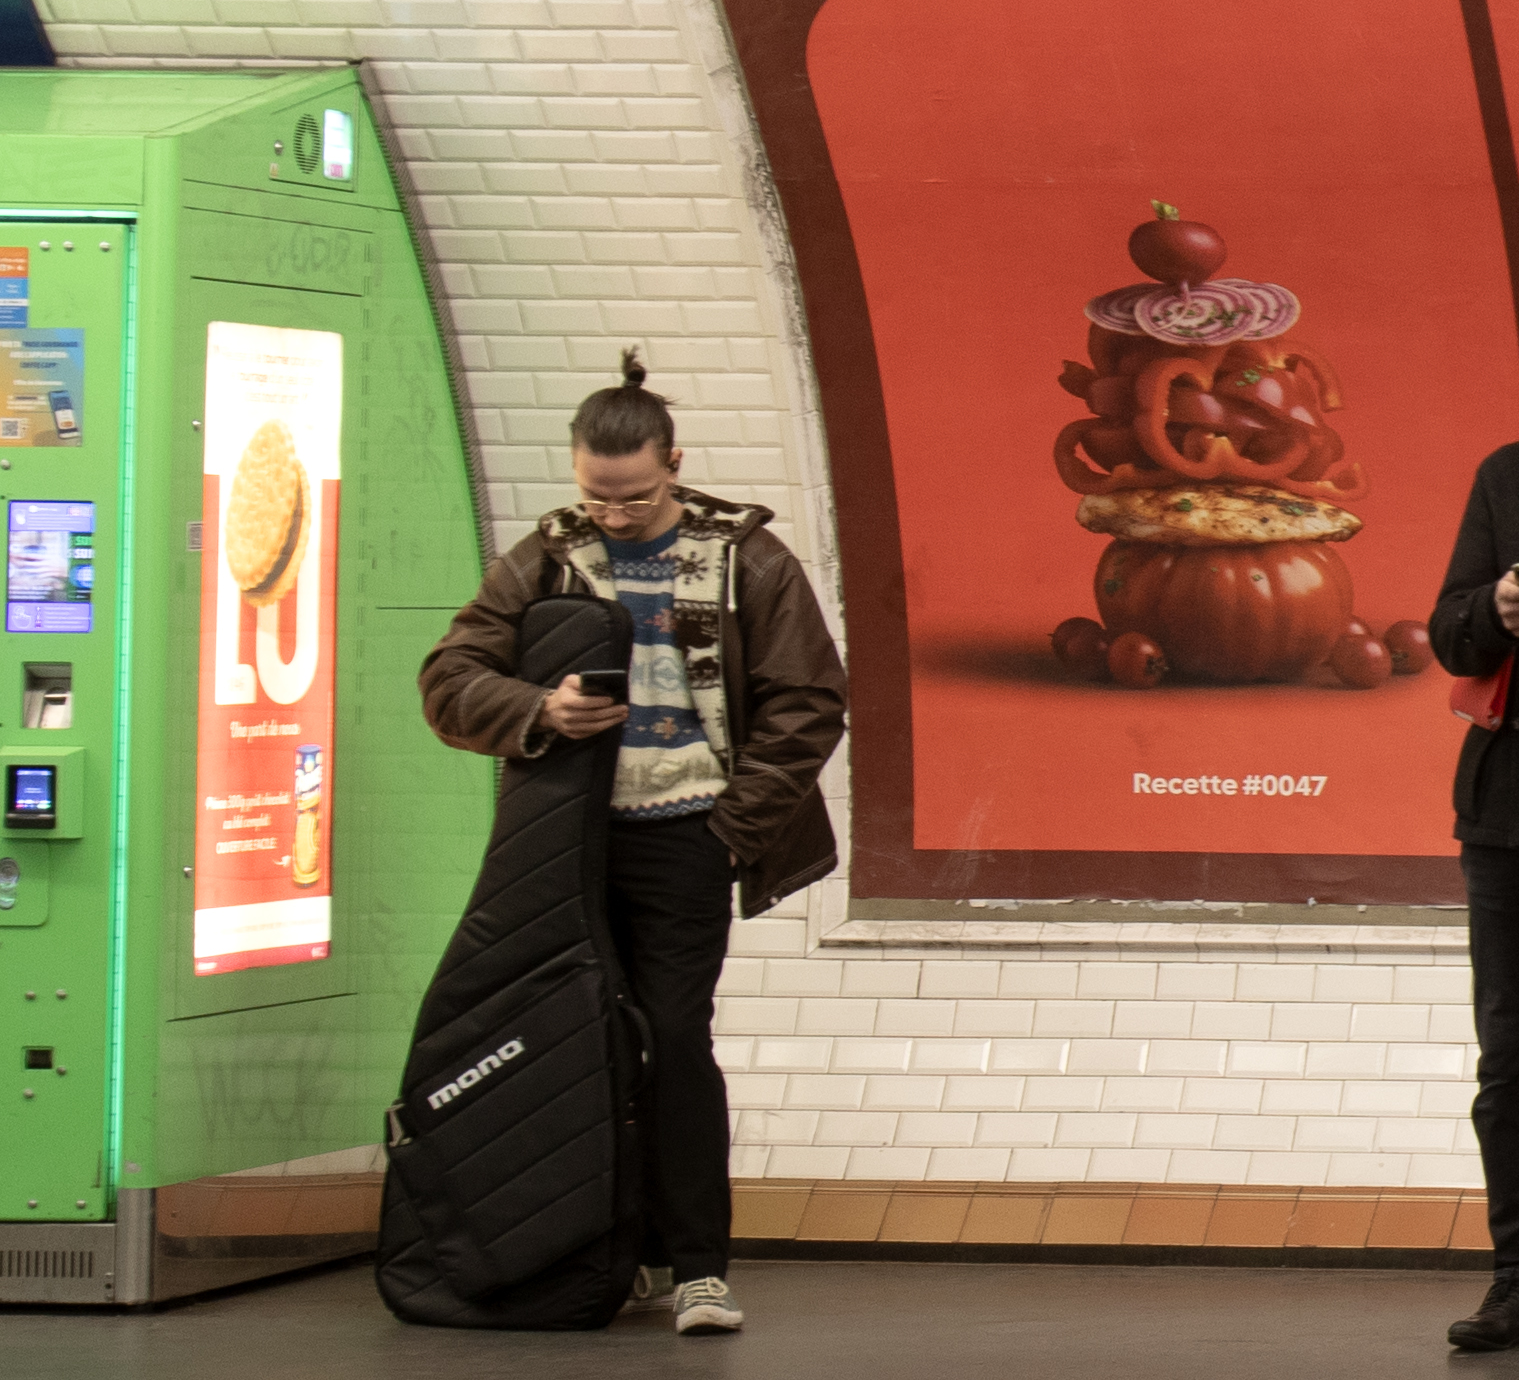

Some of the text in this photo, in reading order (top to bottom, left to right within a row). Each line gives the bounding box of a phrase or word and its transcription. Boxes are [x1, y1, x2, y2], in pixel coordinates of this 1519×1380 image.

[1132, 773, 1328, 797] Recette #0047
[427, 1038, 525, 1110] mono
